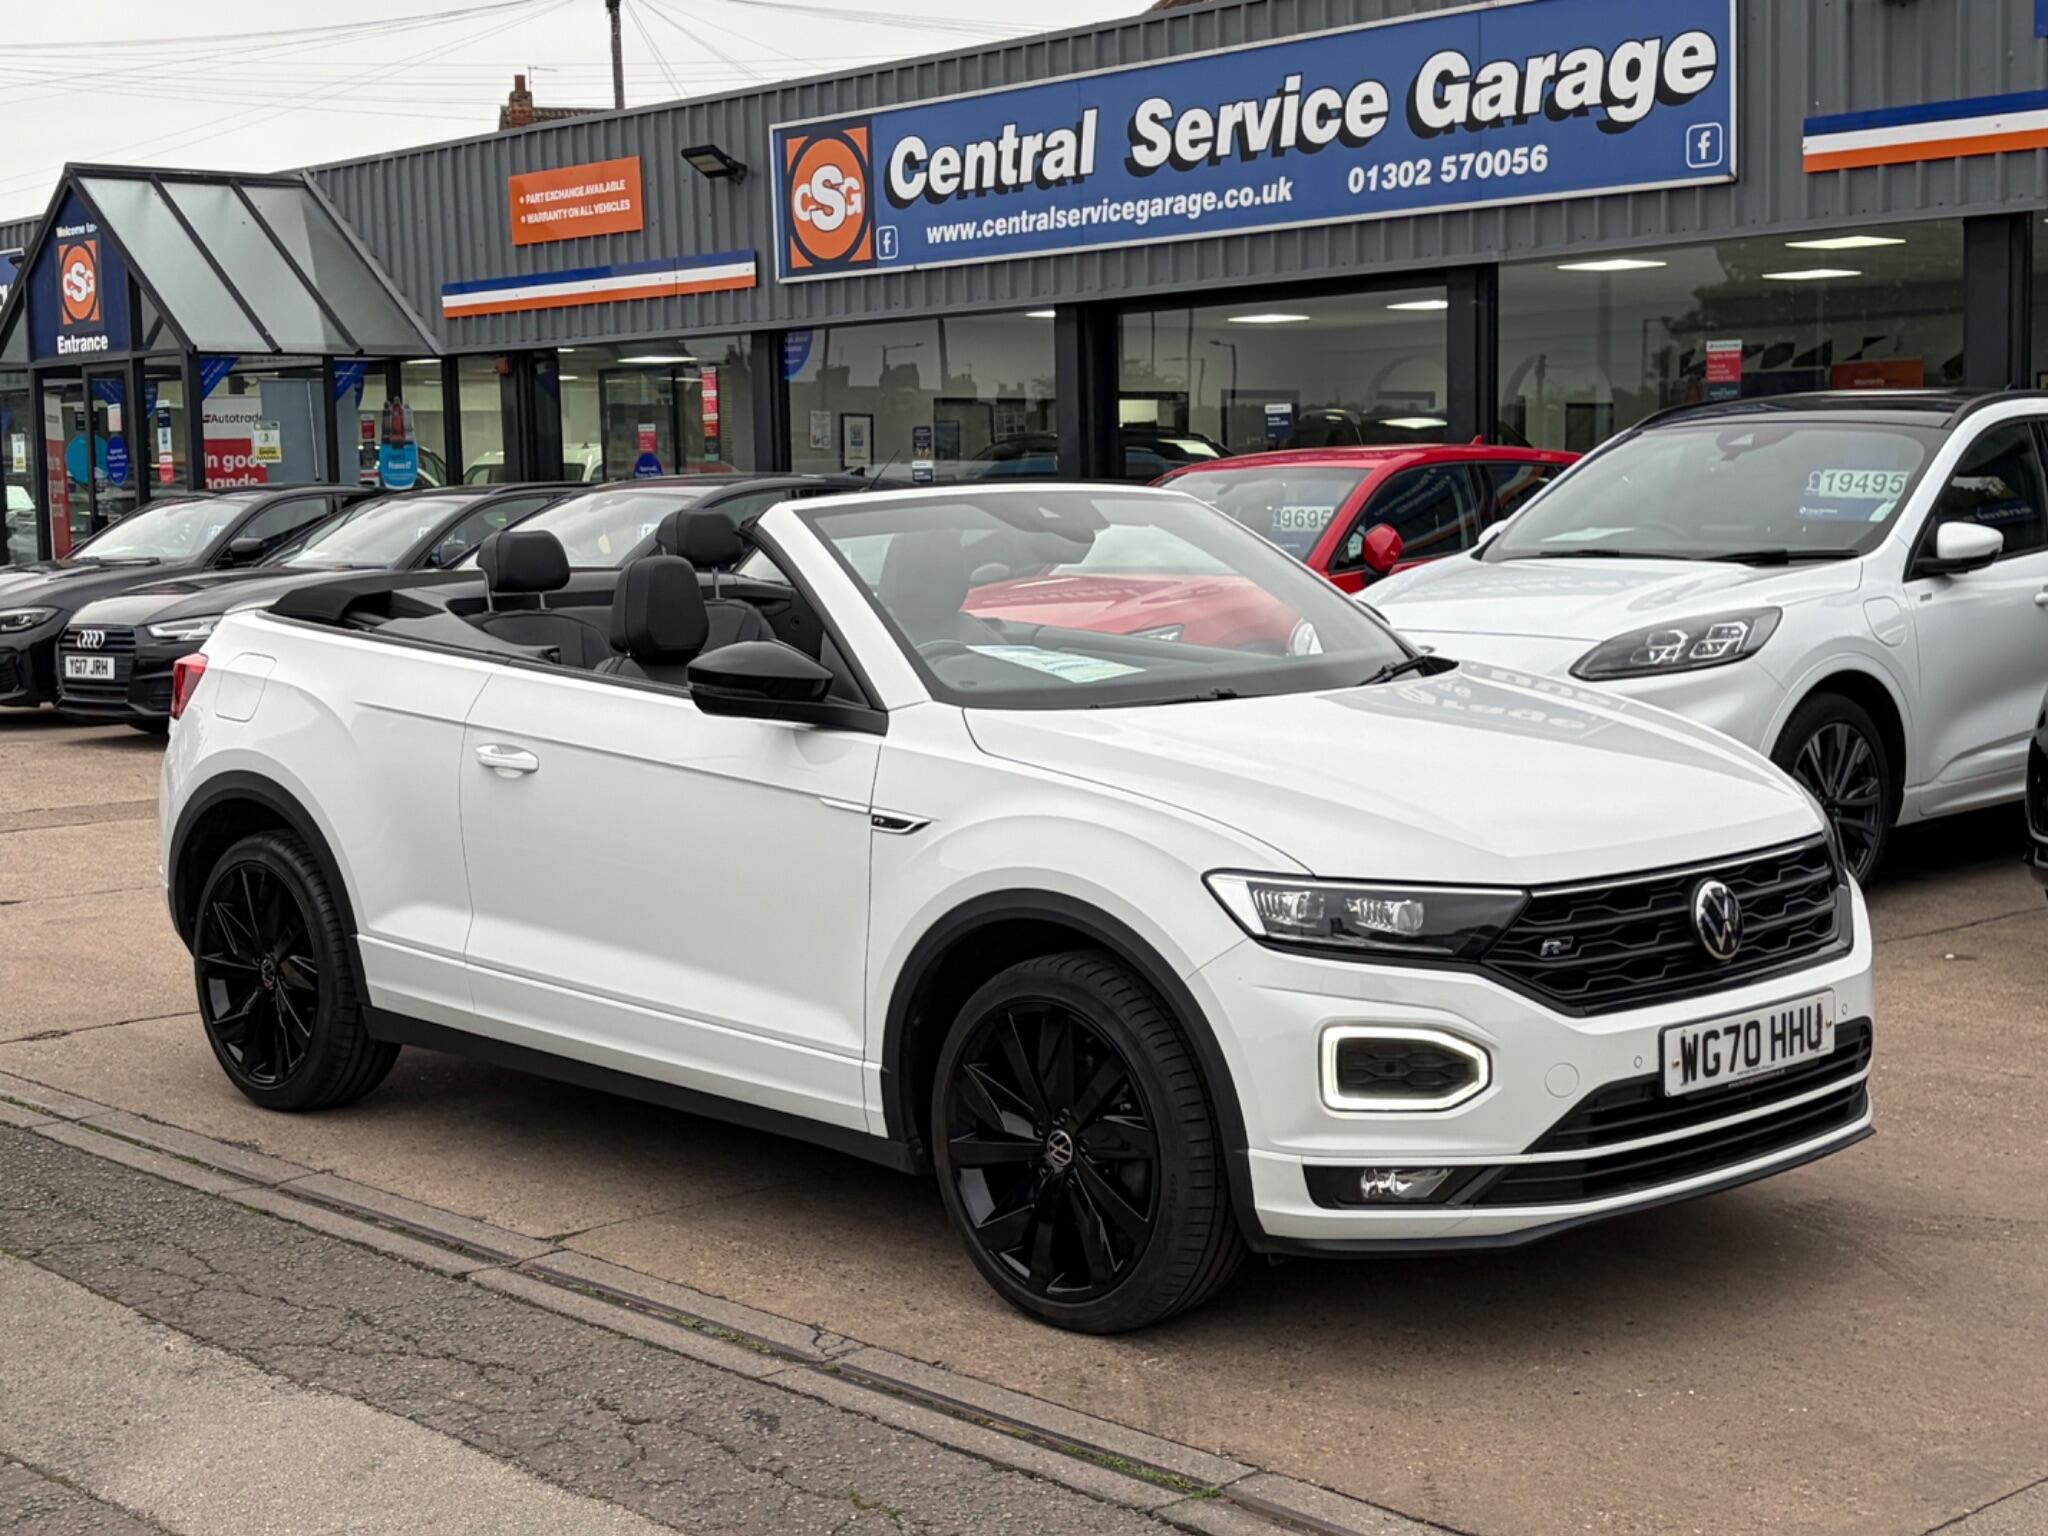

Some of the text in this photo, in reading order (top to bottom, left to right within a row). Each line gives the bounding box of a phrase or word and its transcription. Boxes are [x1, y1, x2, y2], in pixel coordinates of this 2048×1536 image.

[888, 29, 1718, 201] Central Service Garage
[1348, 144, 1548, 194] 01302 570056
[525, 179, 626, 205] PART EXCHANGE AVAILABLE
[794, 164, 862, 232] CSG
[526, 199, 631, 224] WARRANTY ON ALL VEHICLES
[926, 176, 1293, 244] www.centralservicegarage.co.uk
[56, 224, 86, 238] Welcome
[63, 262, 95, 302] CSG
[57, 335, 109, 354] Entrance
[1806, 470, 1906, 495] £19495
[69, 659, 109, 676] YG17 JRH
[1680, 1002, 1824, 1084] WG70 HHU
